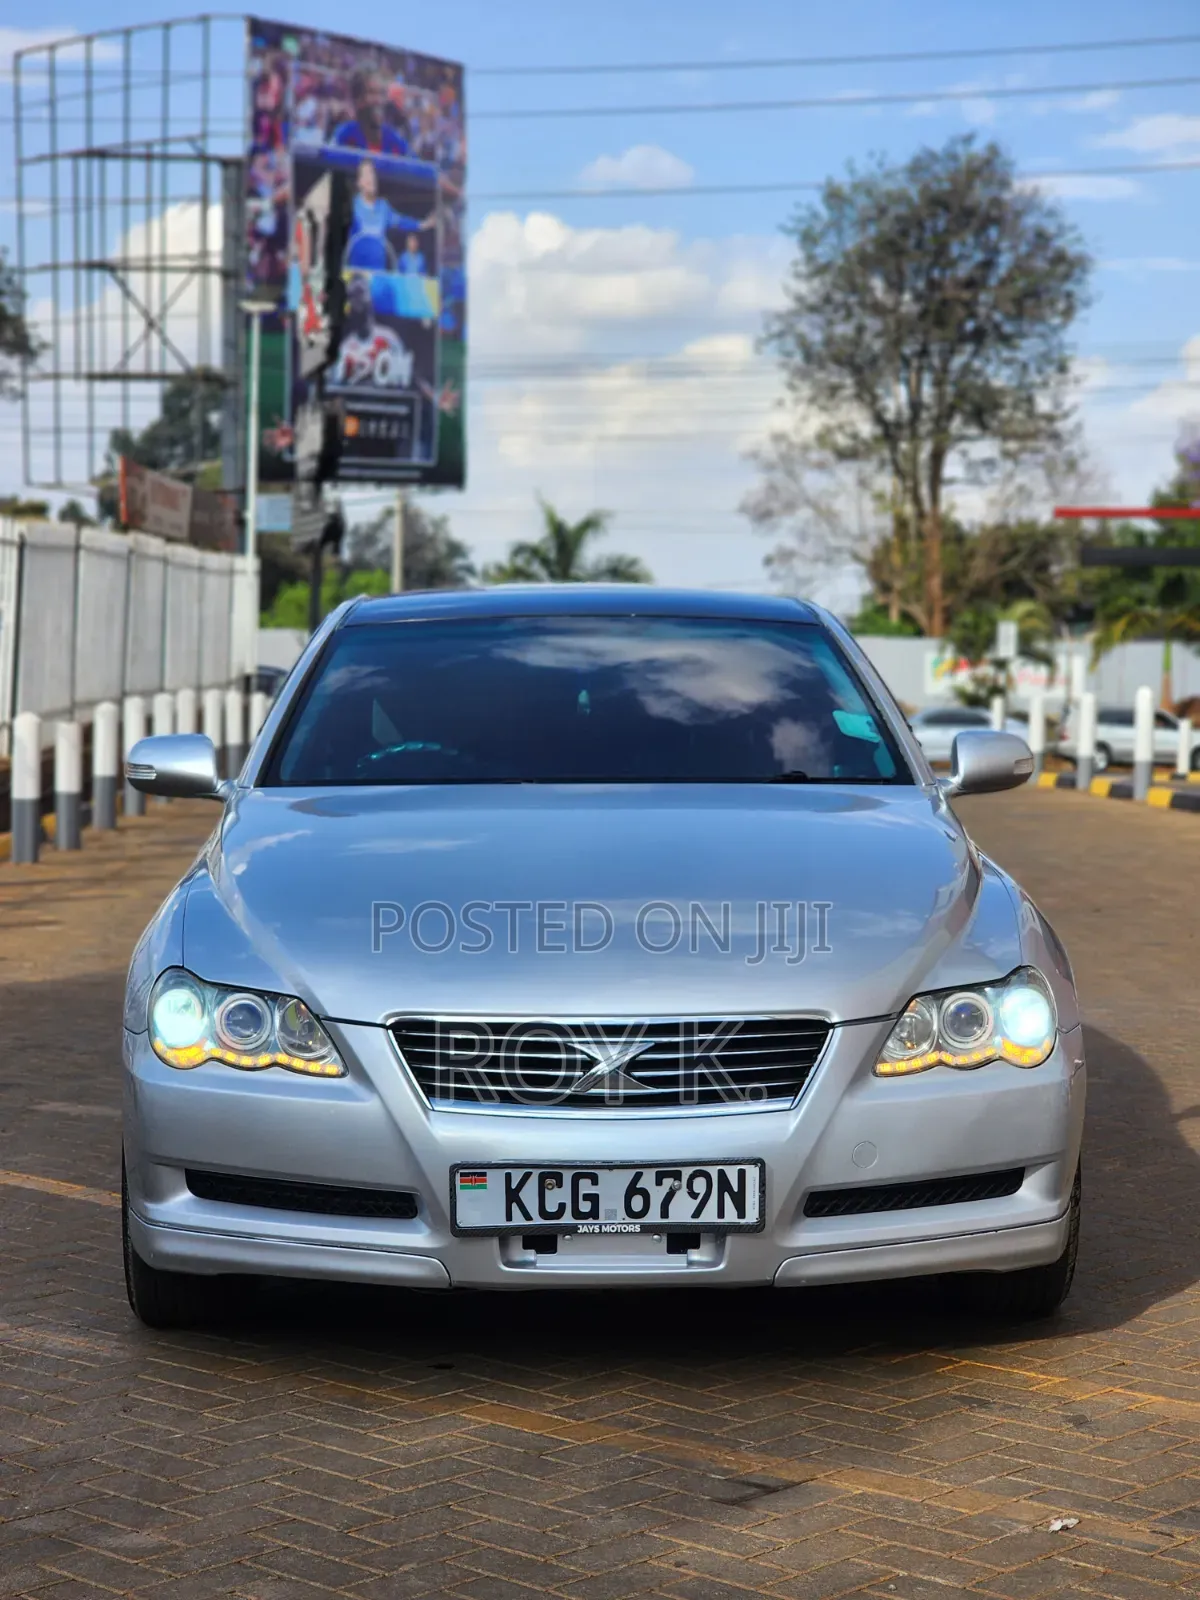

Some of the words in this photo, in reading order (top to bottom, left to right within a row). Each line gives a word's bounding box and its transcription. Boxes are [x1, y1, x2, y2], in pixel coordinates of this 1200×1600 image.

[504, 1171, 600, 1222] KCG
[623, 1168, 746, 1220] 679N
[577, 1224, 600, 1233] JAYS
[601, 1224, 641, 1233] MOTORS
